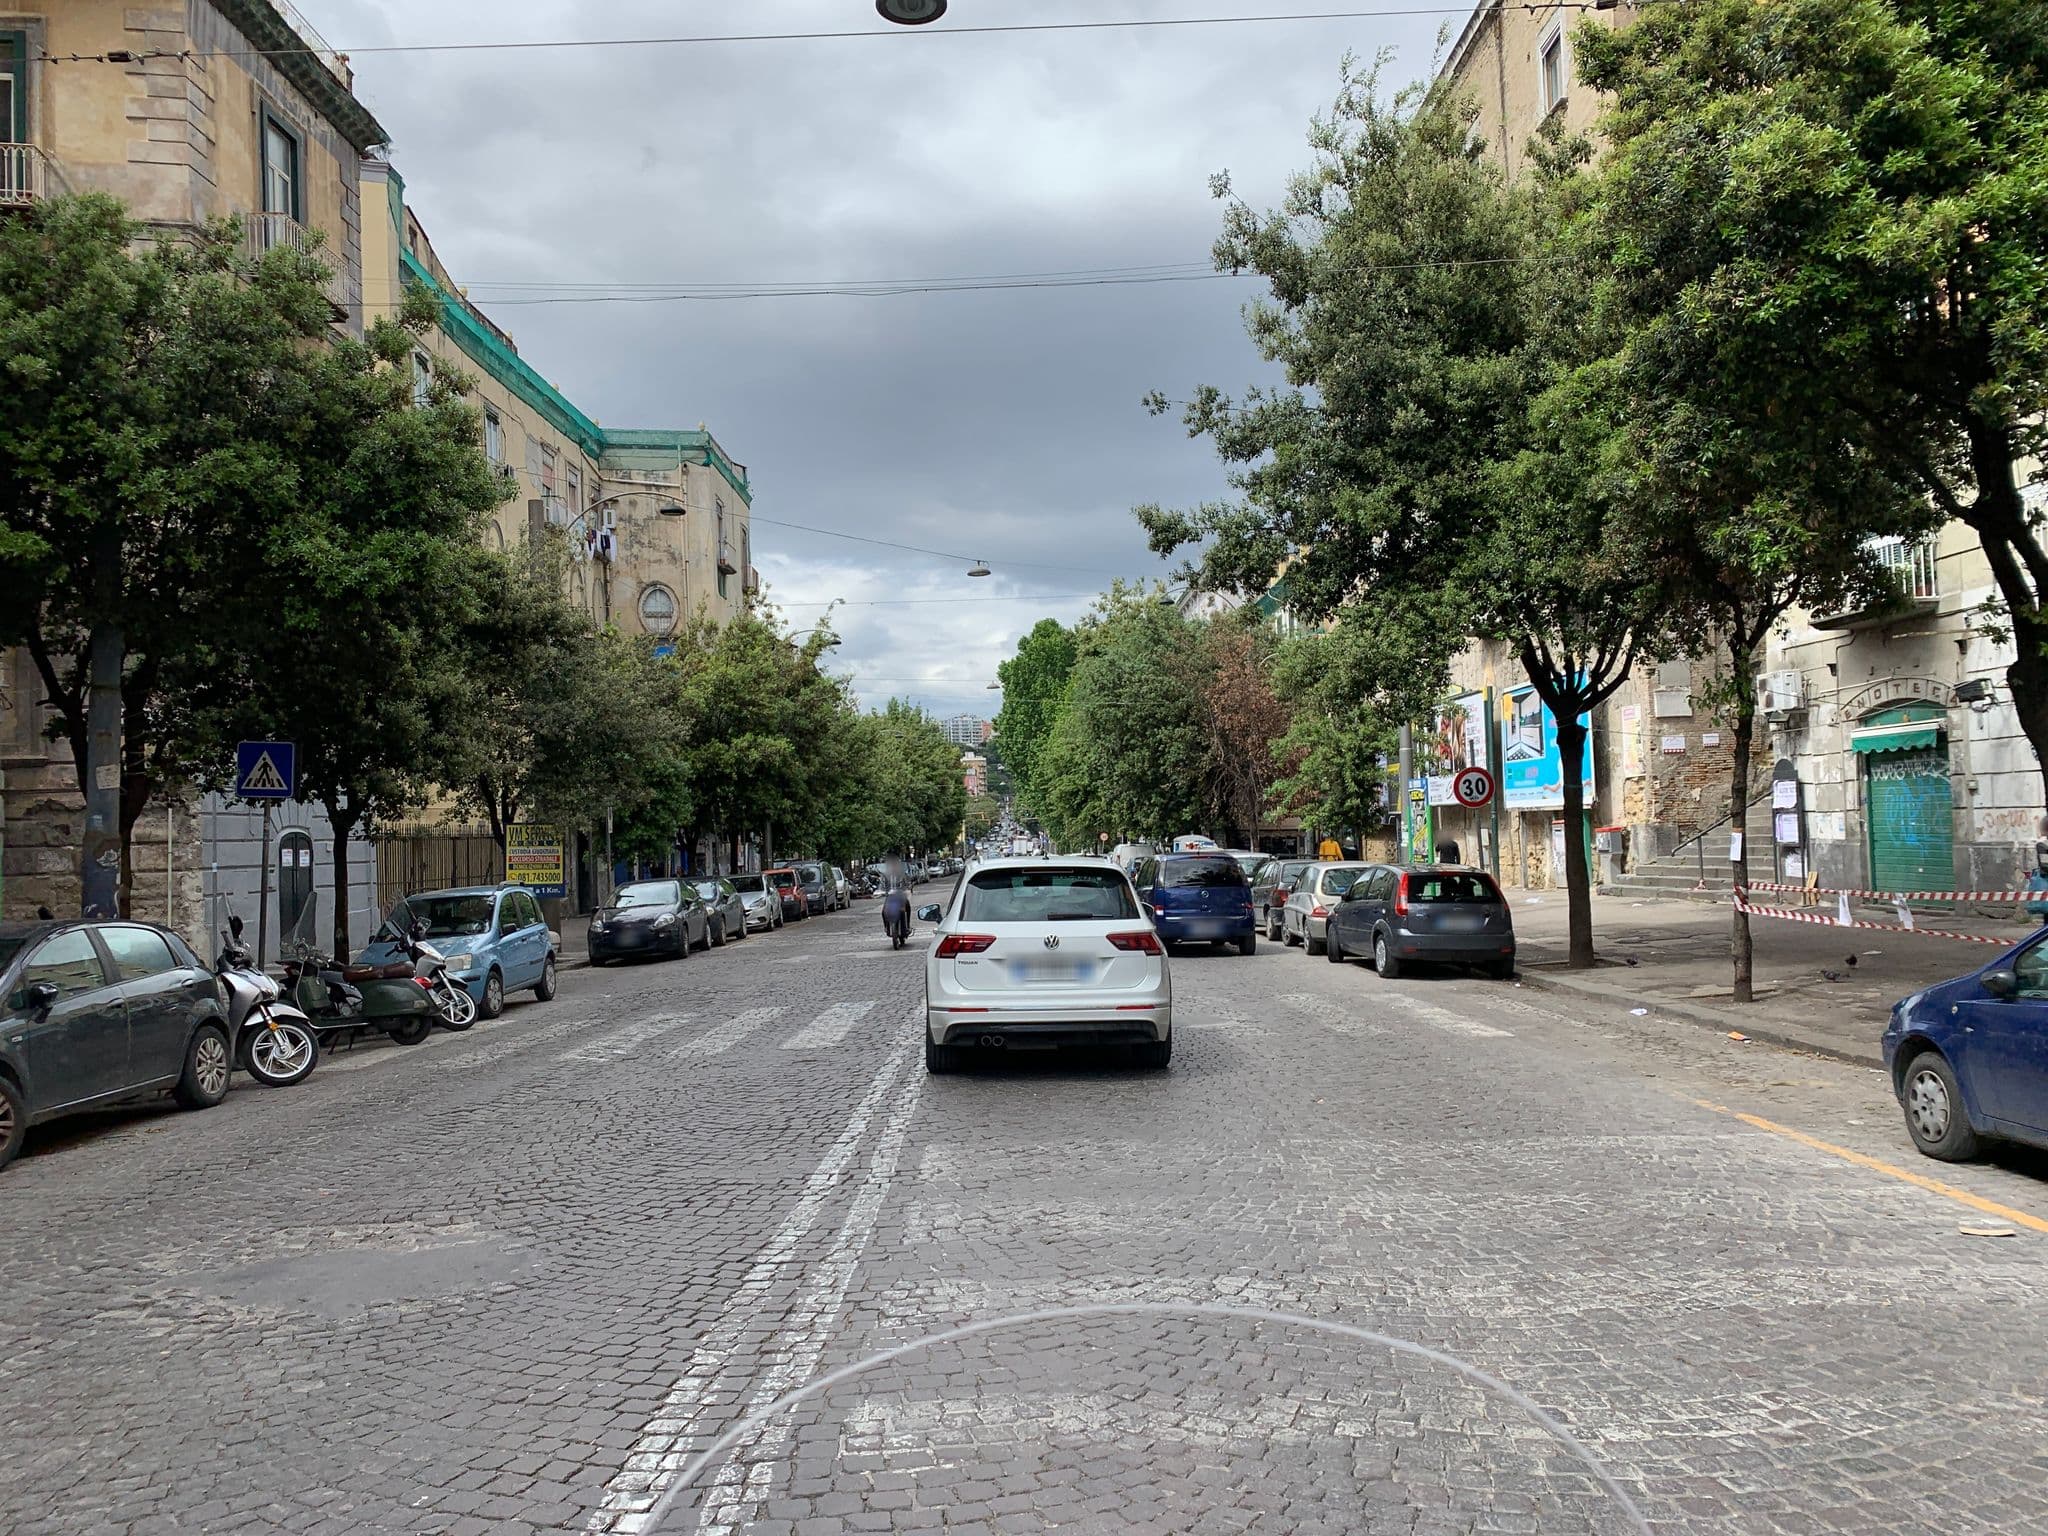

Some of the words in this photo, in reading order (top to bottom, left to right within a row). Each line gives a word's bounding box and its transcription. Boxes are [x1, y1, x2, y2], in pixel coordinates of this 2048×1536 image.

[1844, 682, 1958, 719] ENOTECA
[1463, 777, 1486, 797] 30
[509, 826, 523, 841] VM
[518, 872, 560, 882] 081.7435000
